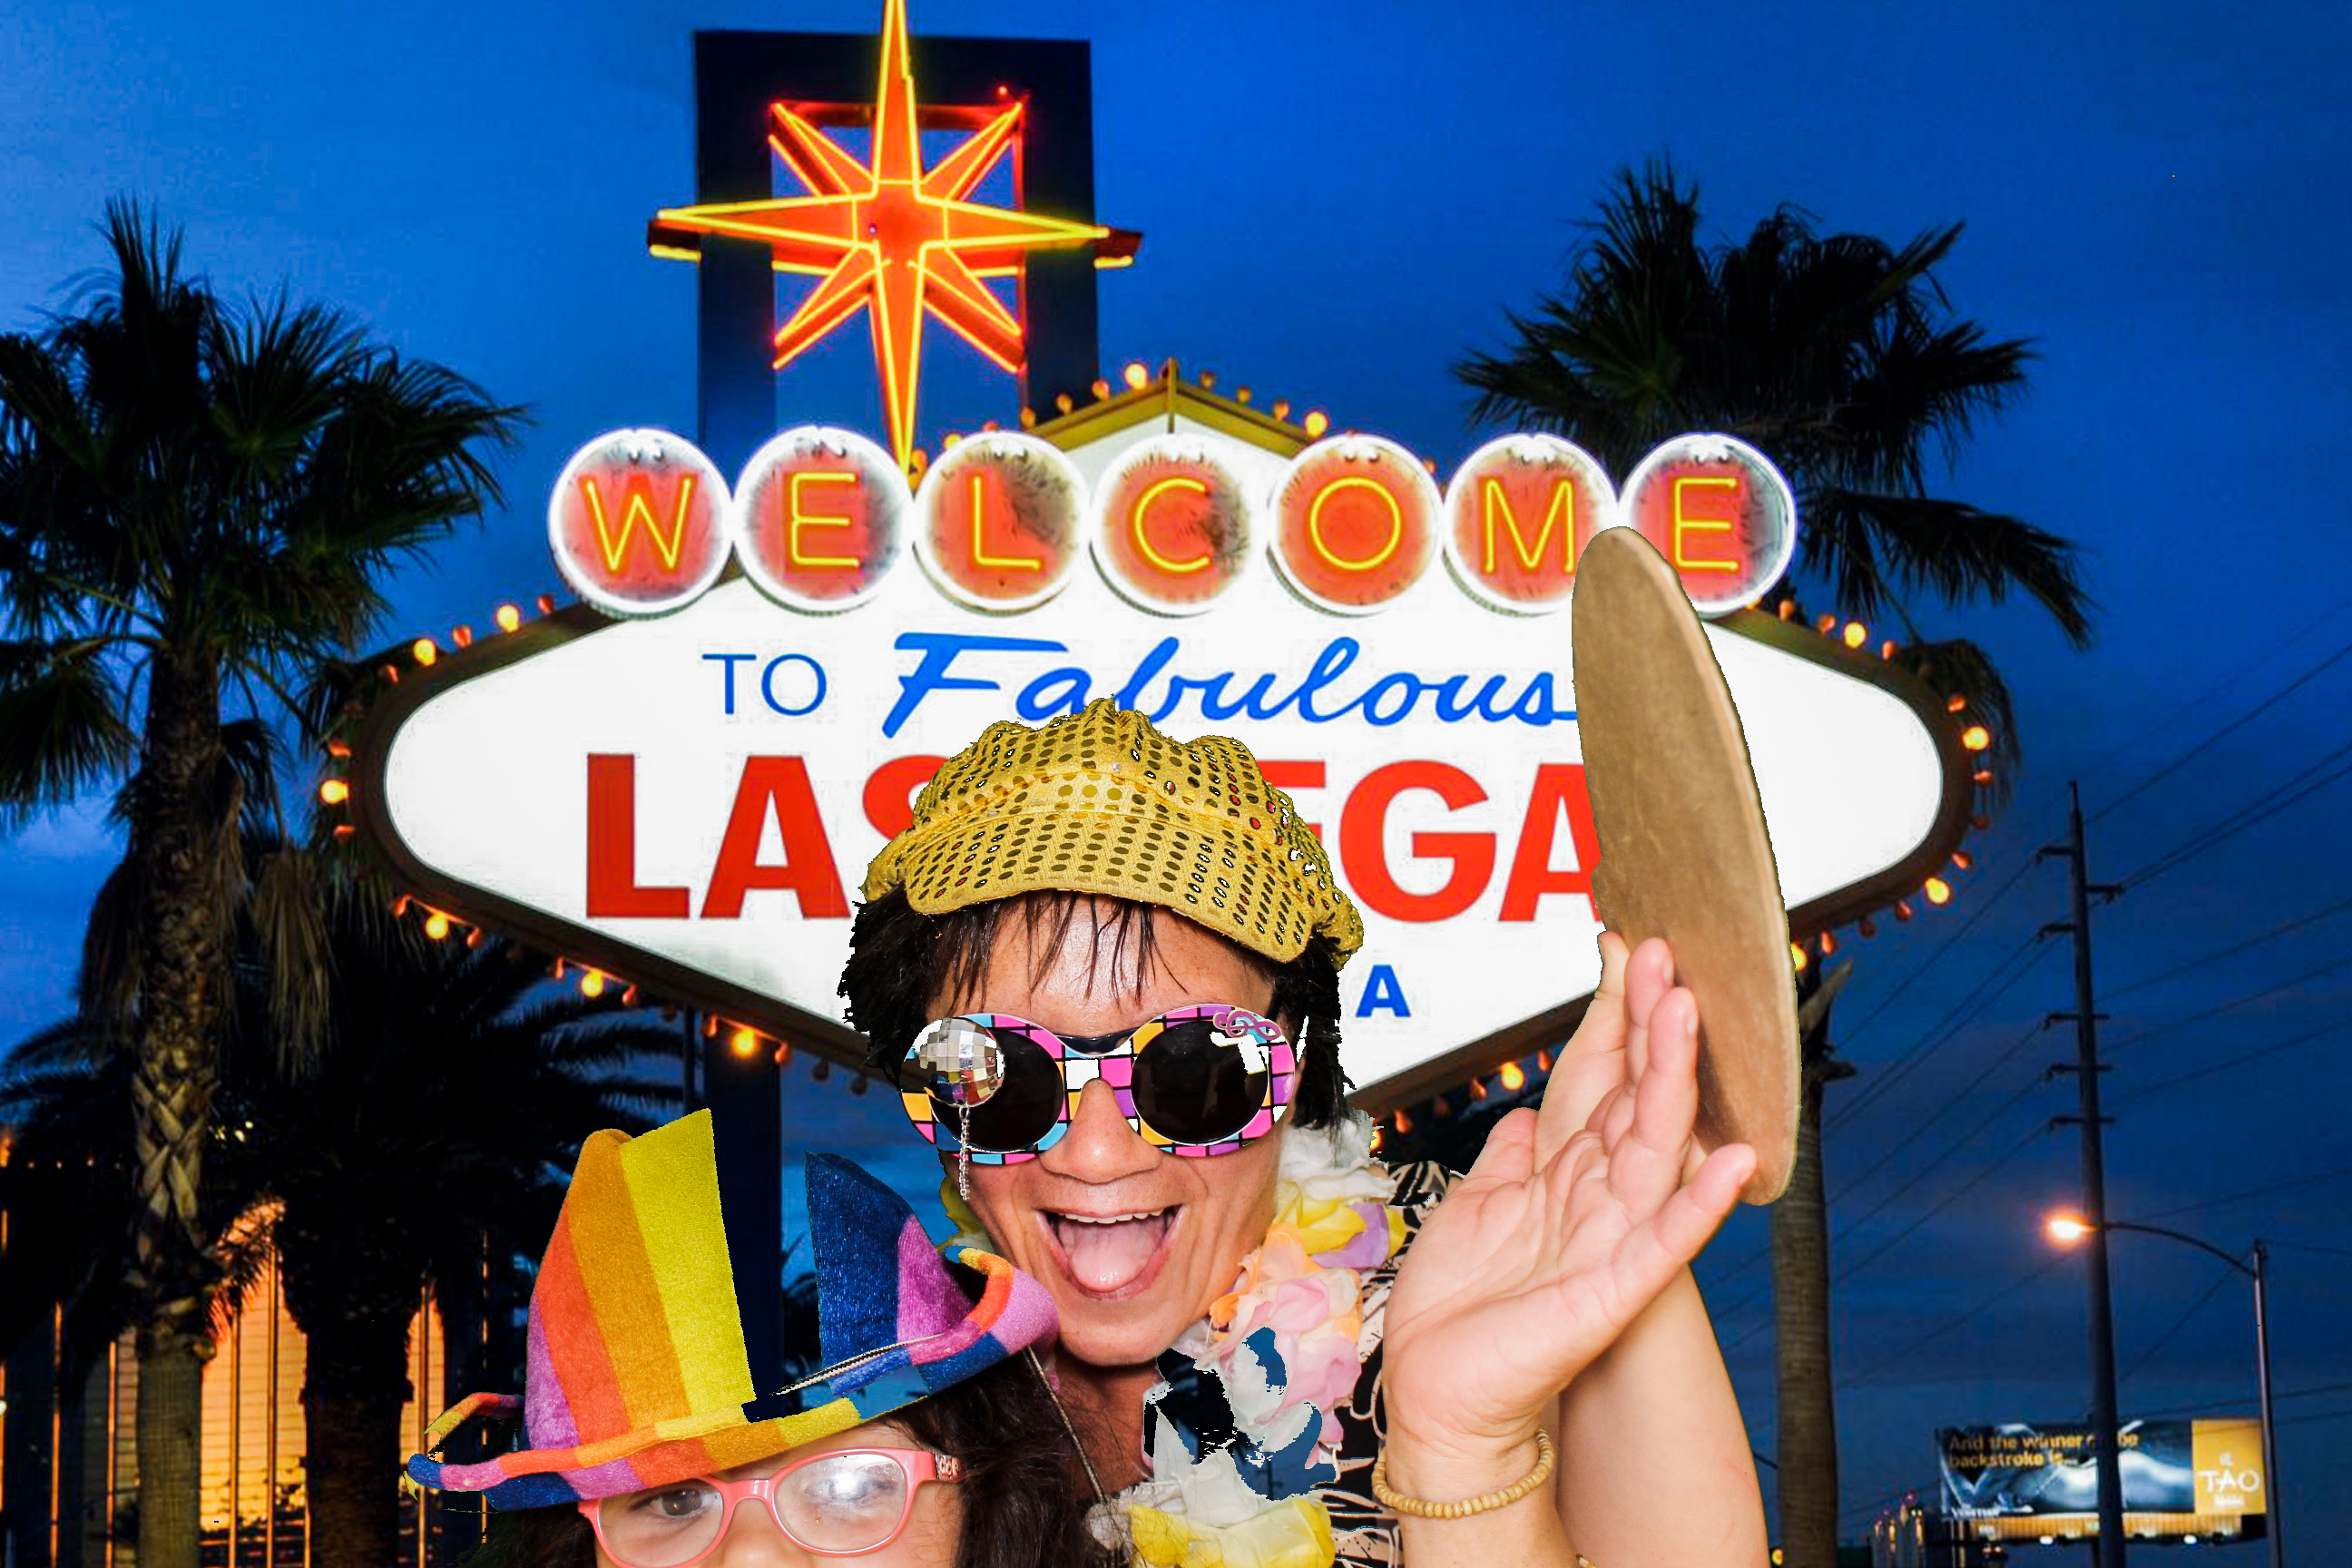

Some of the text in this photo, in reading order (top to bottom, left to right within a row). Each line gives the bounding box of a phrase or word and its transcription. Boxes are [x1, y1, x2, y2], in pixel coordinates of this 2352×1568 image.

[584, 472, 1740, 573] WELCOME
[701, 632, 1579, 740] TO Fabulous
[1949, 1435, 1984, 1450] And
[1989, 1435, 2017, 1449] the
[1949, 1450, 2045, 1467] backstroke
[2197, 1469, 2260, 1494] TAO
